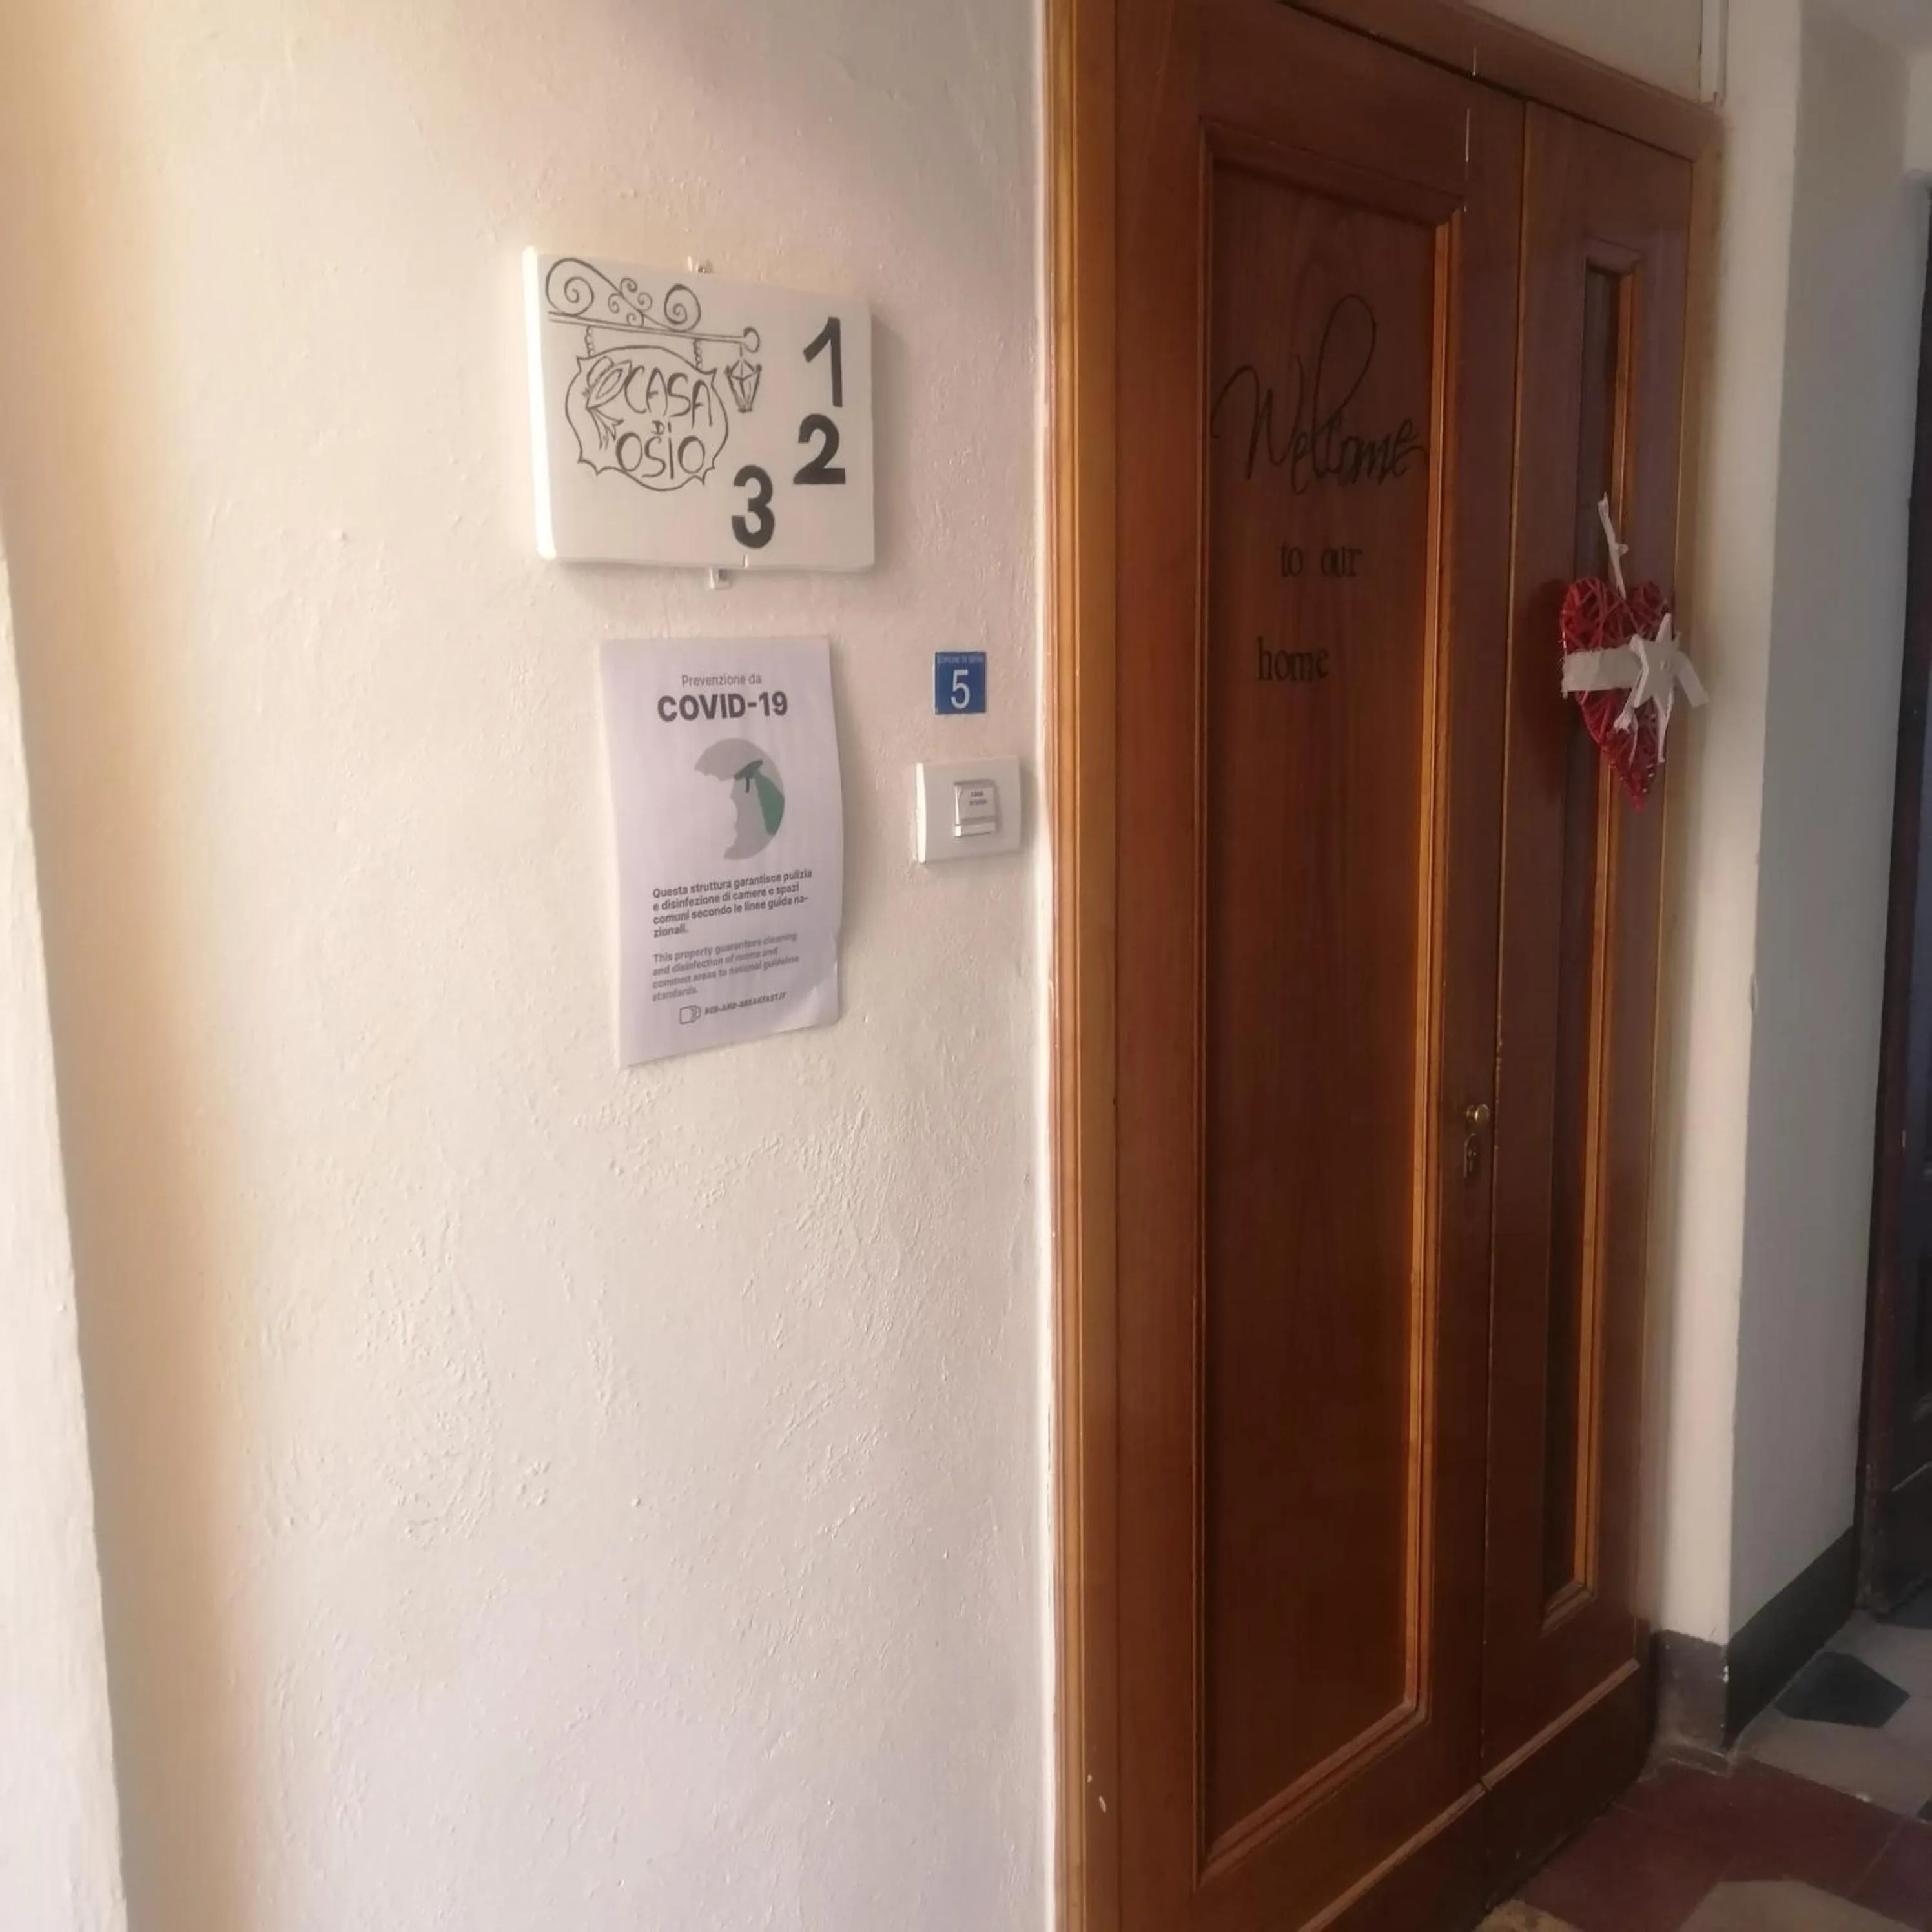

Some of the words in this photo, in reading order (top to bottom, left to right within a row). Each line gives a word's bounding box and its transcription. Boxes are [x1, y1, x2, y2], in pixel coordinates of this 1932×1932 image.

[803, 316, 843, 407] 1
[624, 365, 713, 430] CASA
[1211, 293, 1428, 495] Welcome
[615, 432, 706, 480] OSIO
[793, 413, 846, 484] 2
[731, 464, 776, 549] 3
[1279, 543, 1304, 579] to
[1321, 544, 1362, 578] our
[1257, 637, 1330, 682] home
[681, 674, 746, 686] Prevenzione
[748, 673, 763, 684] da
[951, 669, 971, 710] 5
[657, 690, 788, 722] COVID-19
[653, 886, 688, 898] Questa
[690, 880, 732, 894] struttura
[734, 872, 781, 889] garantisce
[783, 869, 812, 883] pulizia
[661, 895, 720, 911] disinfezione
[722, 892, 731, 901] di
[732, 887, 766, 901] camere
[776, 881, 800, 896] spazi
[653, 910, 690, 925] comuni
[692, 904, 732, 919] secondo
[734, 903, 743, 913] le
[744, 900, 766, 911] linee
[768, 896, 793, 910] guida
[653, 923, 690, 938] zionali.
[653, 952, 673, 963] This
[674, 947, 713, 962] property
[653, 965, 670, 976] and
[672, 958, 723, 974] disinfection
[763, 946, 778, 956] and
[718, 969, 727, 978] to
